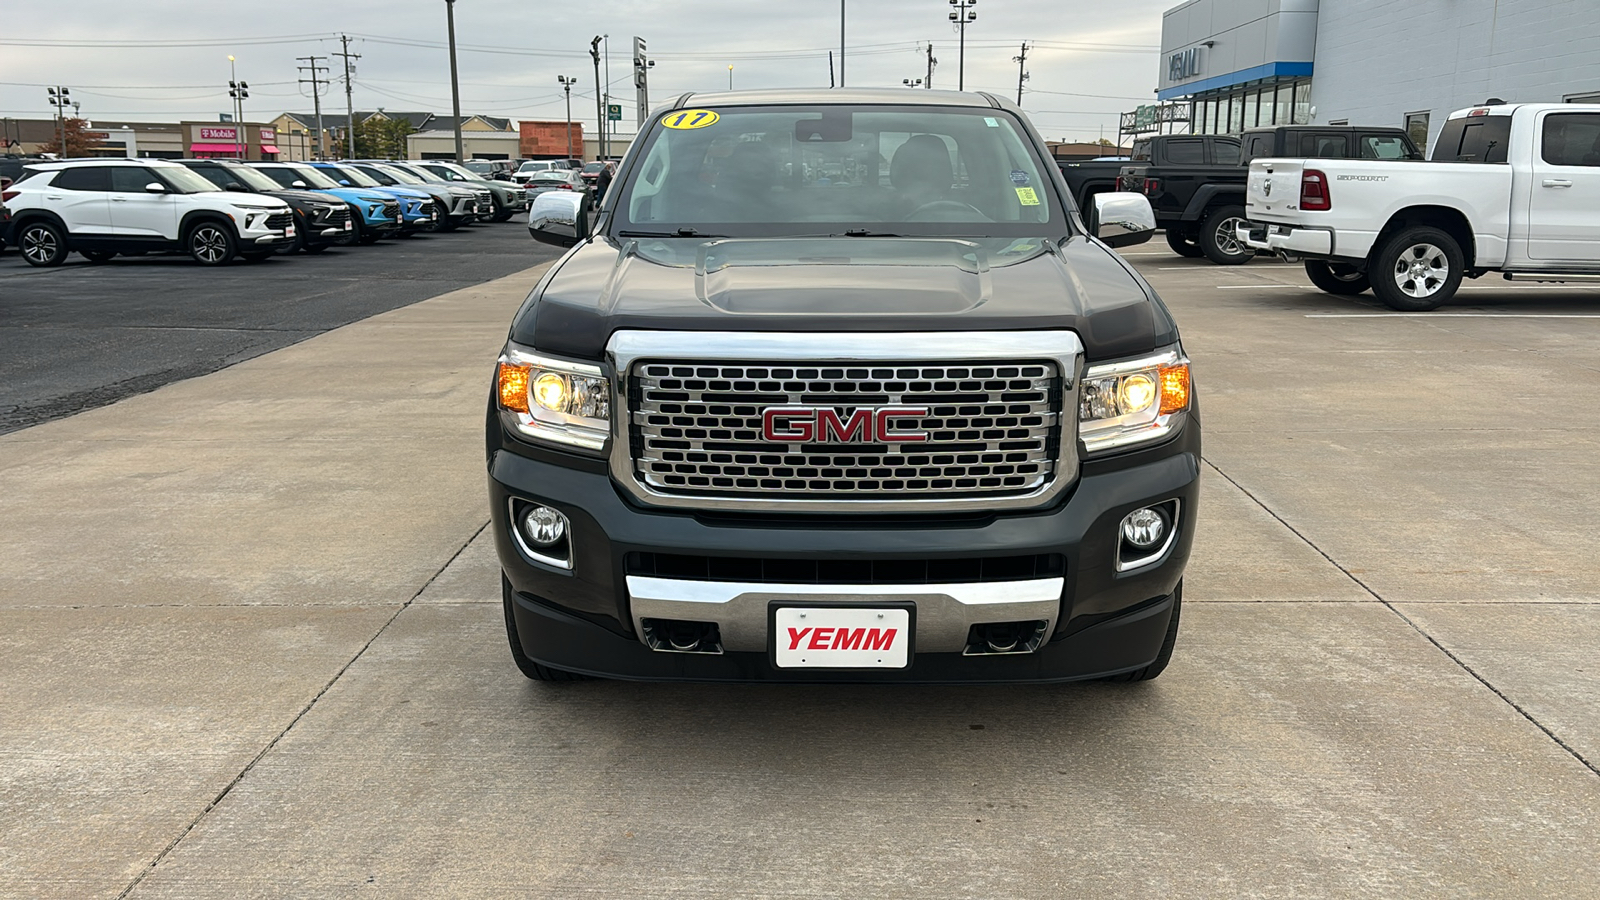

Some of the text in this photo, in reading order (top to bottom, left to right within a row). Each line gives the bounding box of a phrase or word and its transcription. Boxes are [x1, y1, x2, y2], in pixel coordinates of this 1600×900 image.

[673, 112, 708, 127] 17
[210, 129, 235, 138] Mobile
[1336, 174, 1389, 182] SPORT
[762, 406, 929, 443] GMC
[787, 627, 898, 651] YEMM
